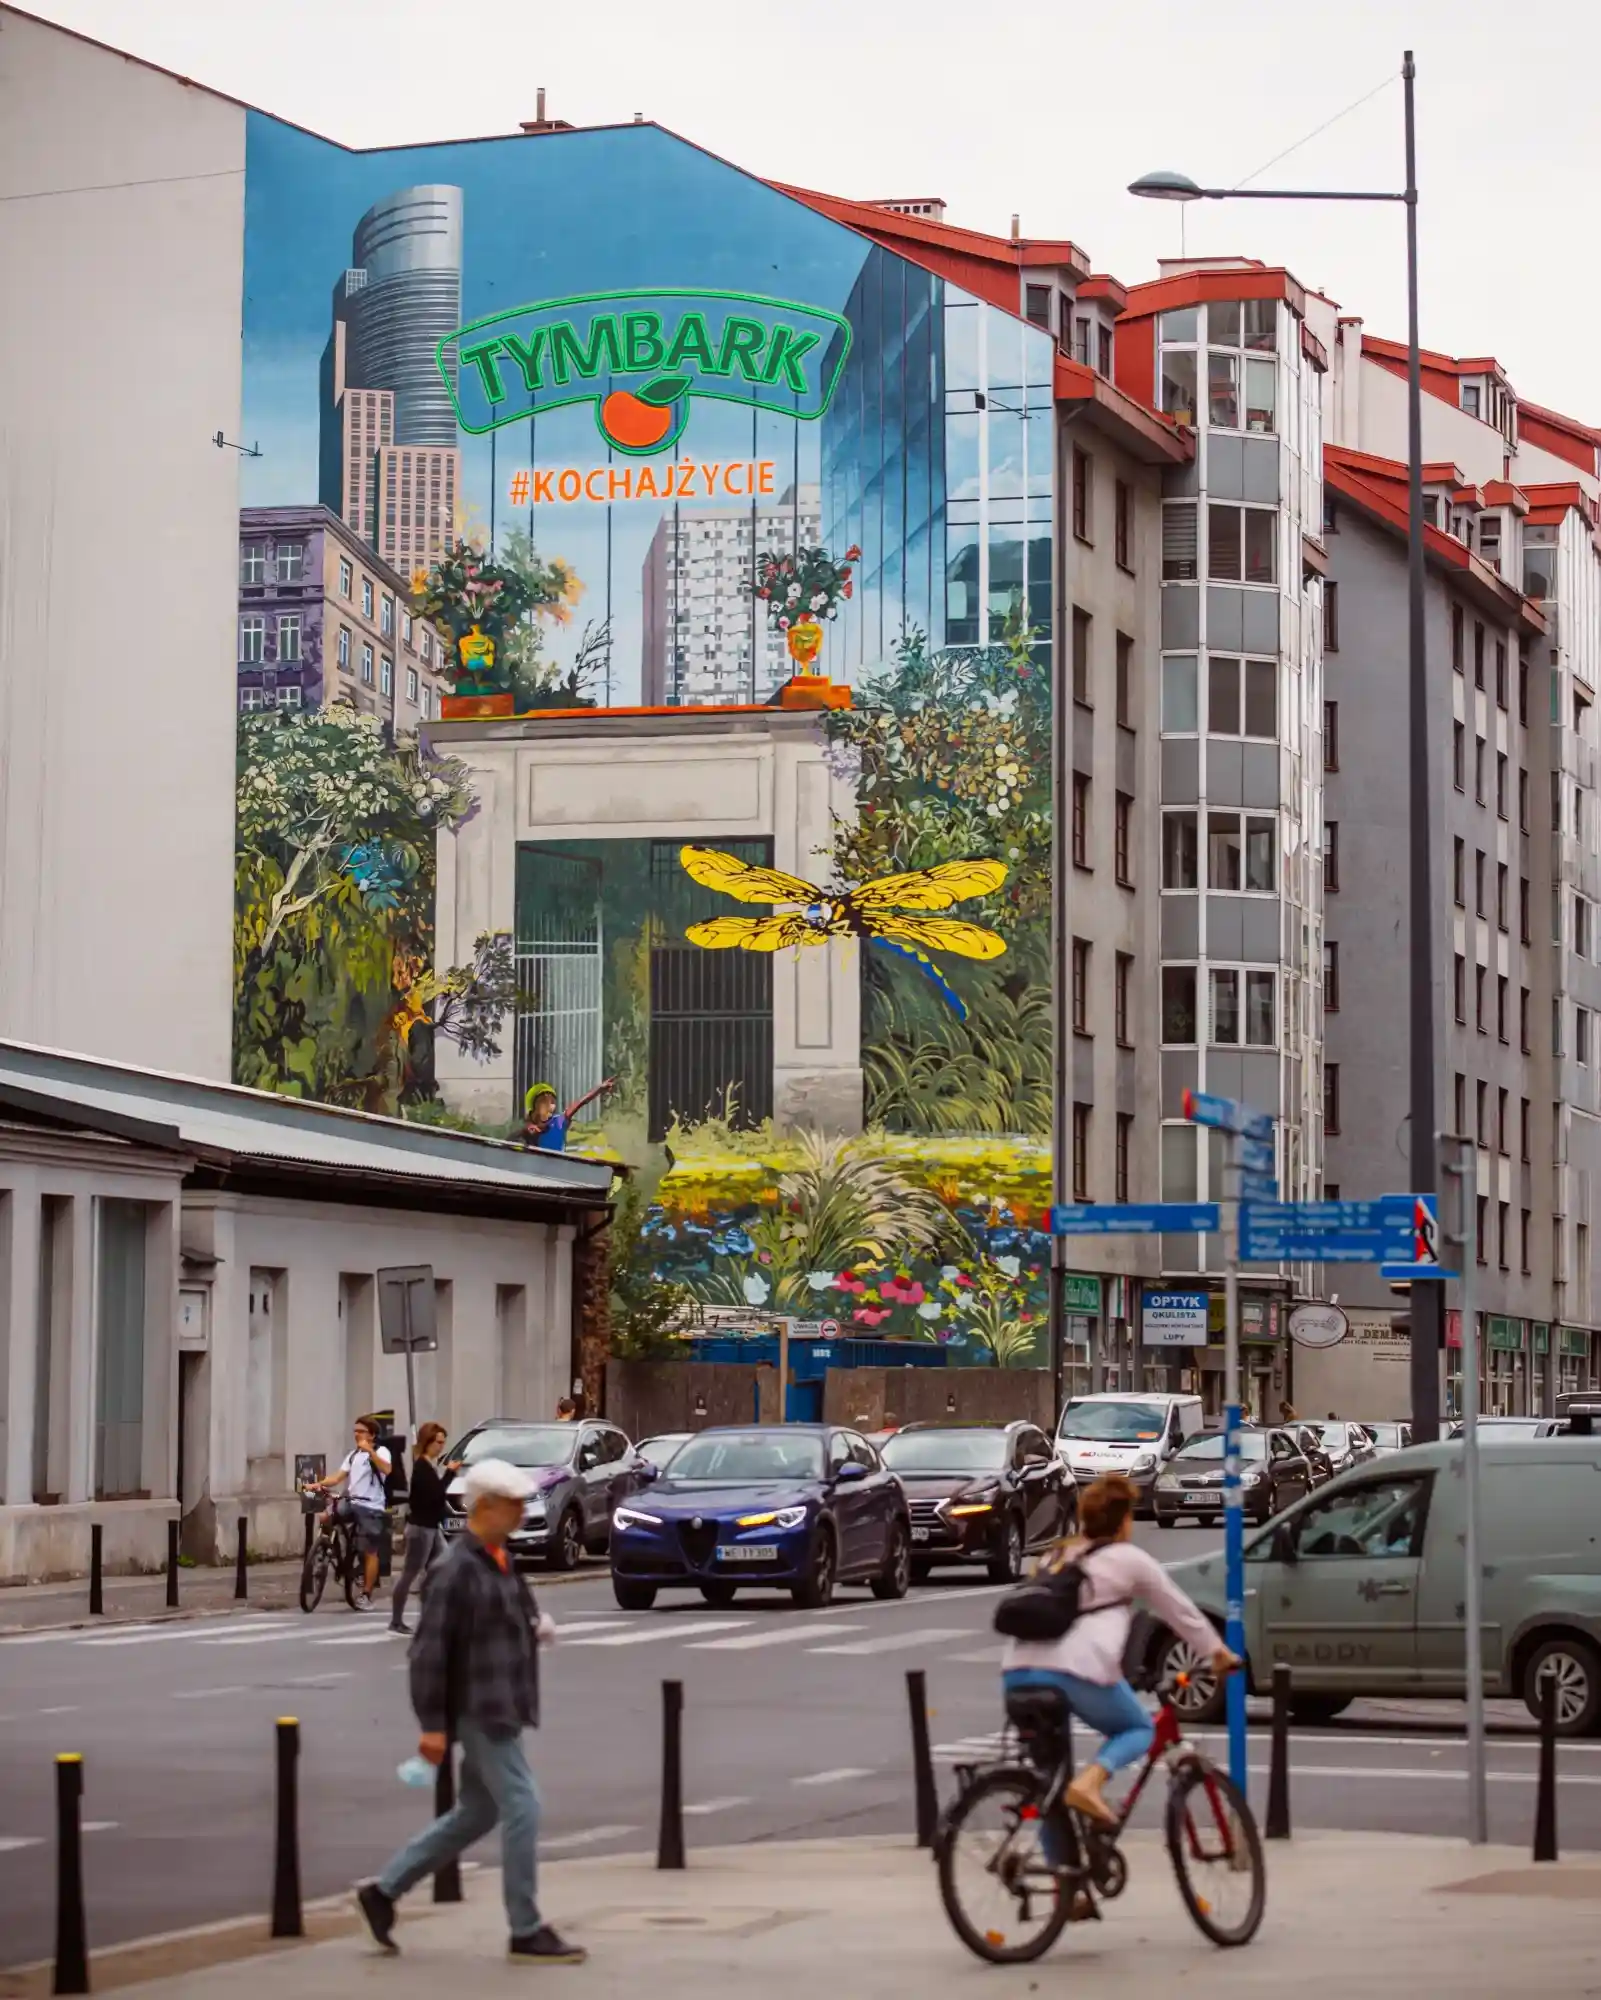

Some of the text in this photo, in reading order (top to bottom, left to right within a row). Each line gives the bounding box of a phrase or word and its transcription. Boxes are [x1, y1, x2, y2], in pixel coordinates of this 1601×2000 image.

[460, 312, 820, 404] TYMBARK
[510, 457, 775, 505] #KOCHAJŻYCIE
[1151, 1295, 1200, 1307] OPTYK
